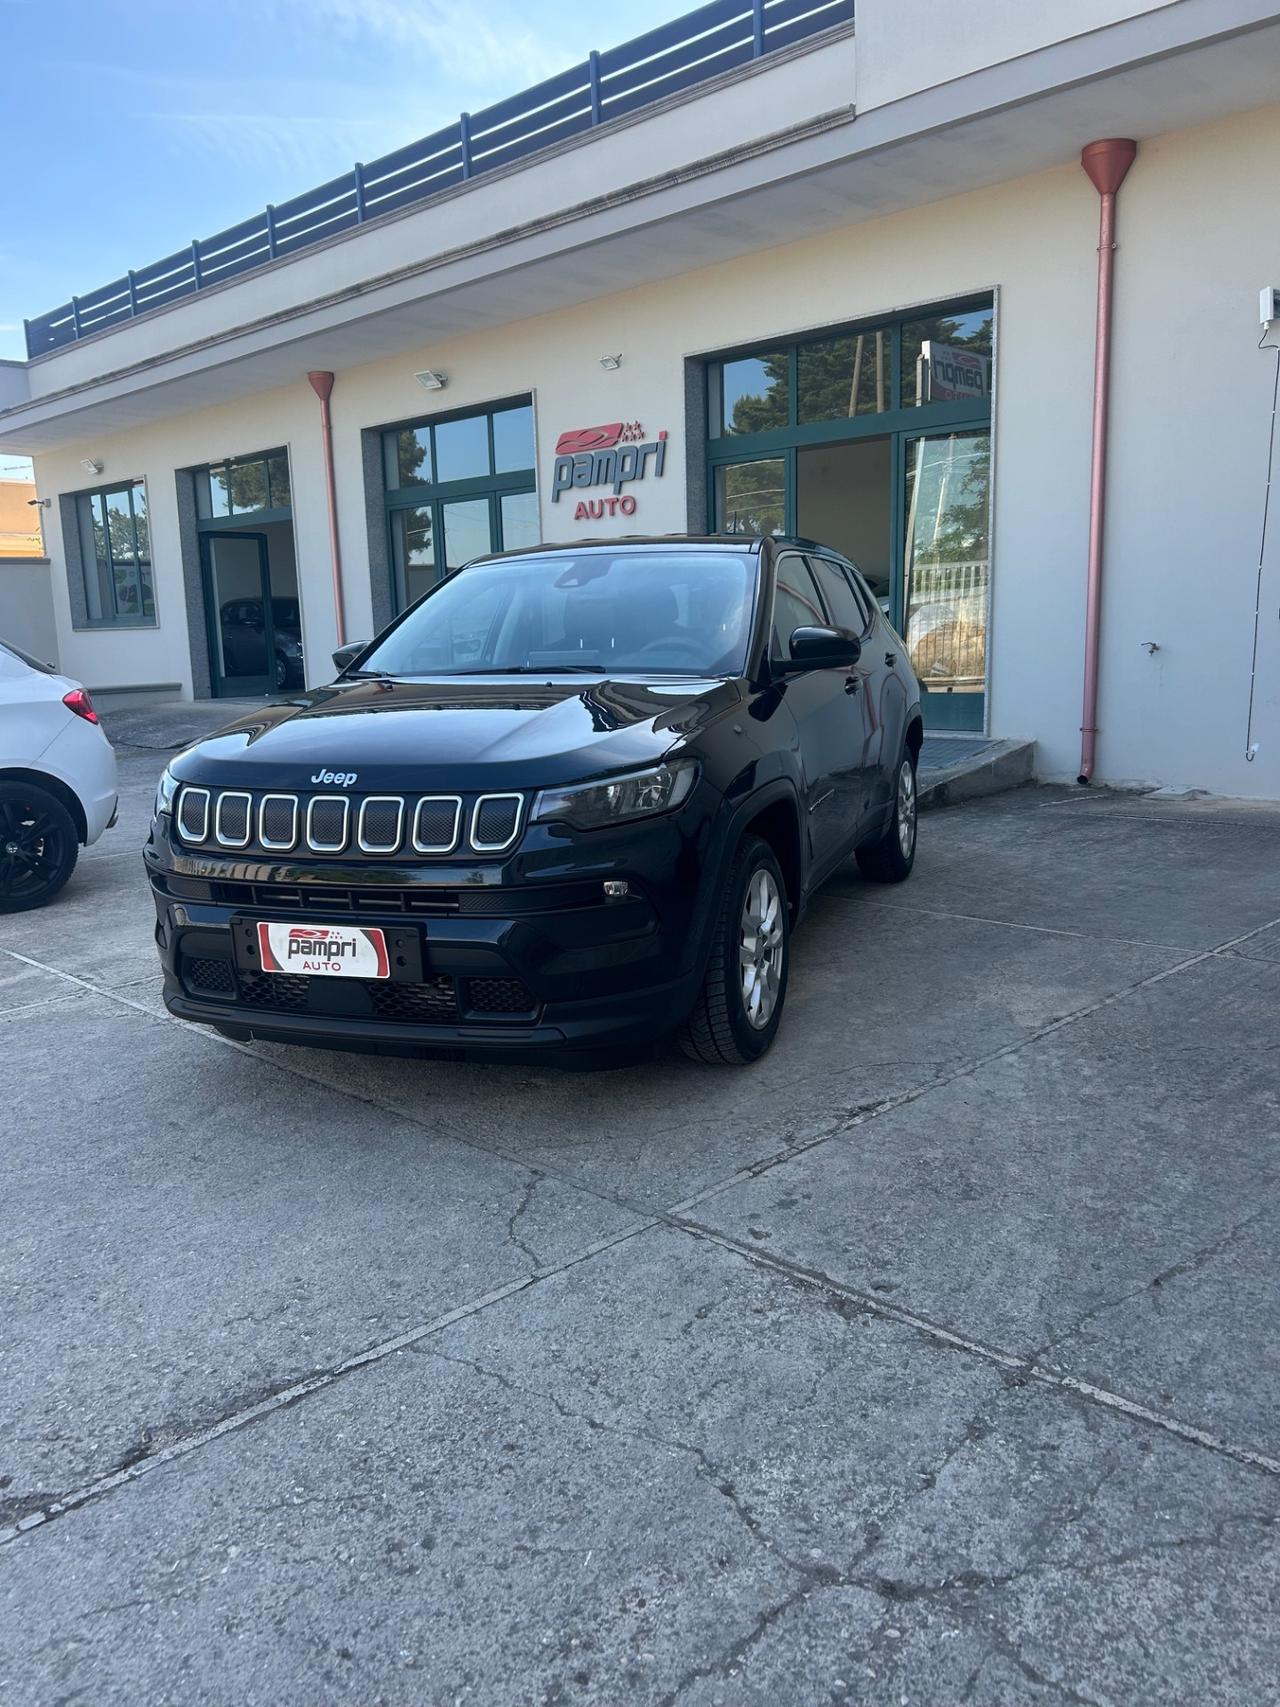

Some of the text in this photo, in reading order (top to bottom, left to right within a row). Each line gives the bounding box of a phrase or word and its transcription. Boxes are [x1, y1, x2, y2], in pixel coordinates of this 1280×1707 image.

[552, 431, 667, 503] pampri
[574, 496, 636, 520] AUTO
[311, 769, 358, 787] Jeep
[288, 938, 356, 961] pampri
[303, 961, 341, 971] AUTO
